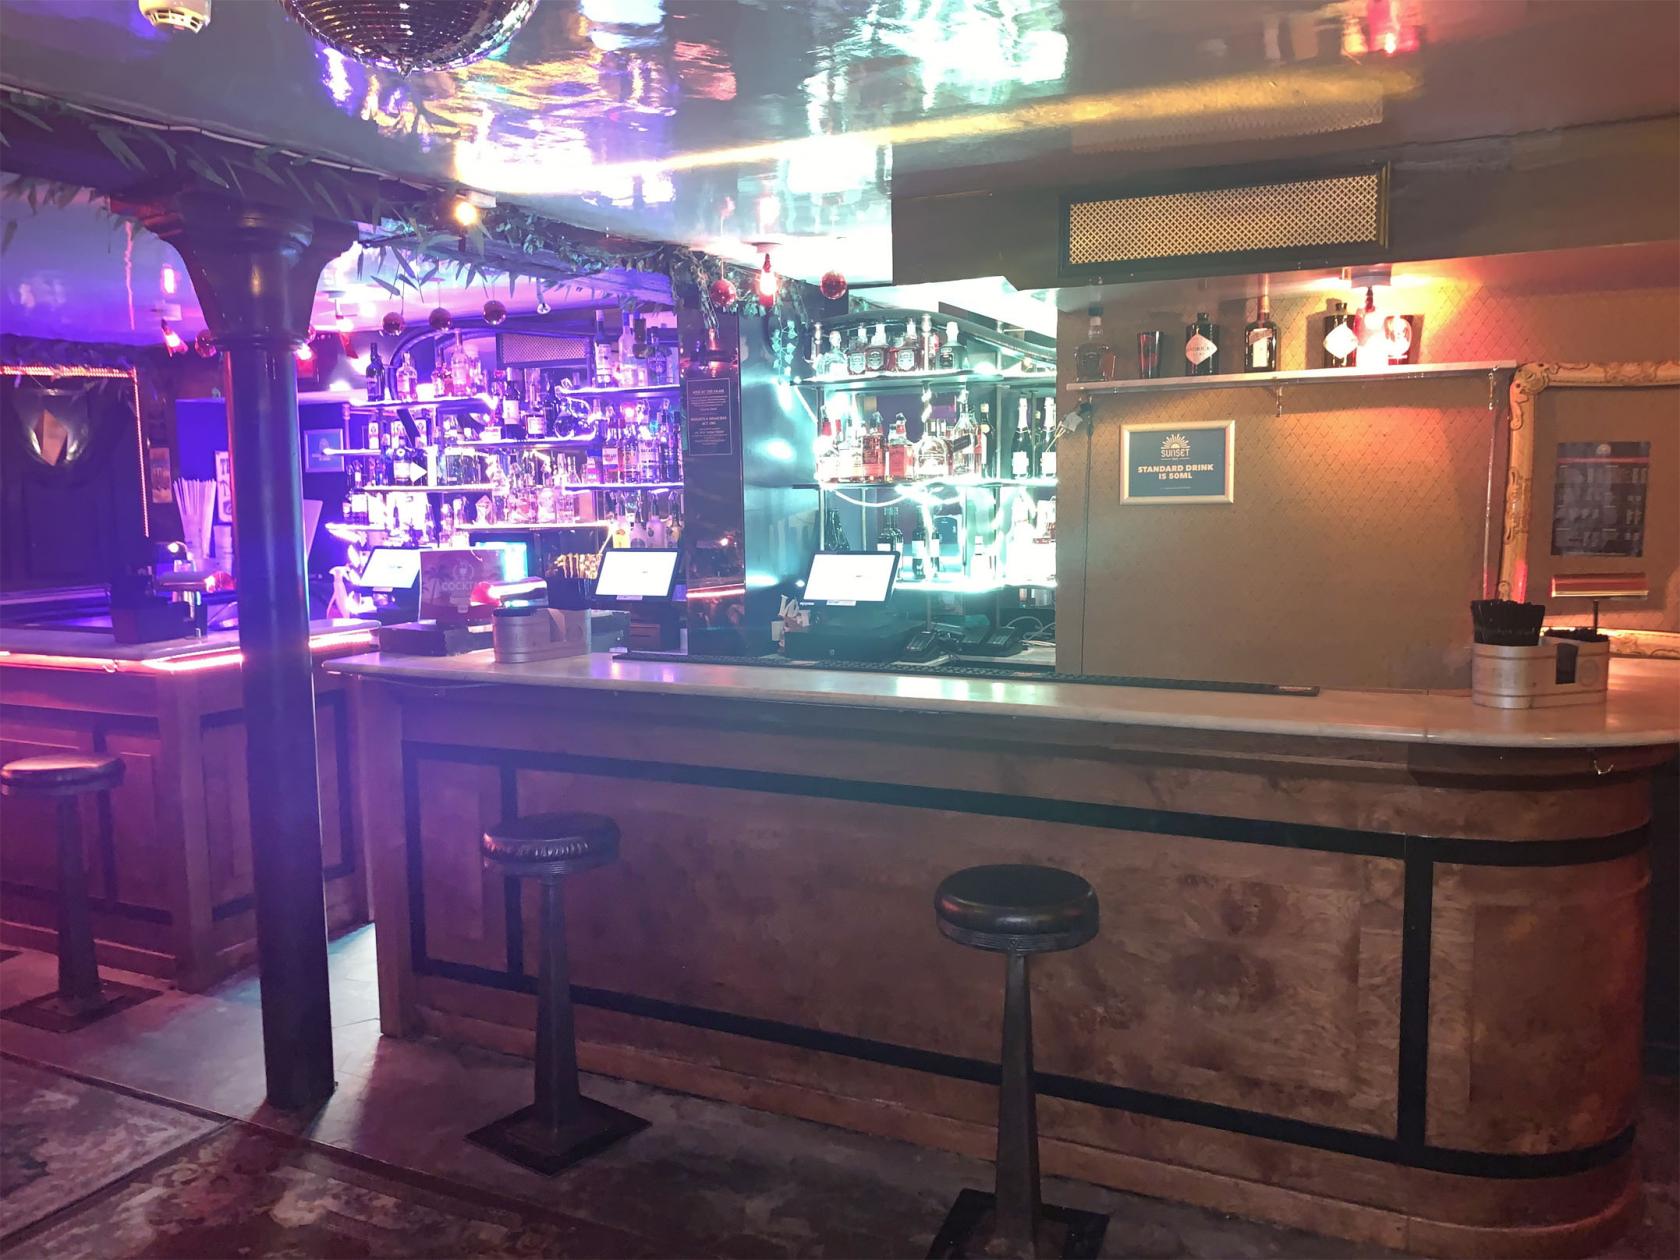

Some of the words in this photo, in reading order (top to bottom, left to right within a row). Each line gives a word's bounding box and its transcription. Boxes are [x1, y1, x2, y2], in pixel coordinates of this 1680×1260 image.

[1161, 449, 1190, 458] SUNSET
[1137, 465, 1184, 473] STANDARD
[1185, 464, 1214, 472] DRINK
